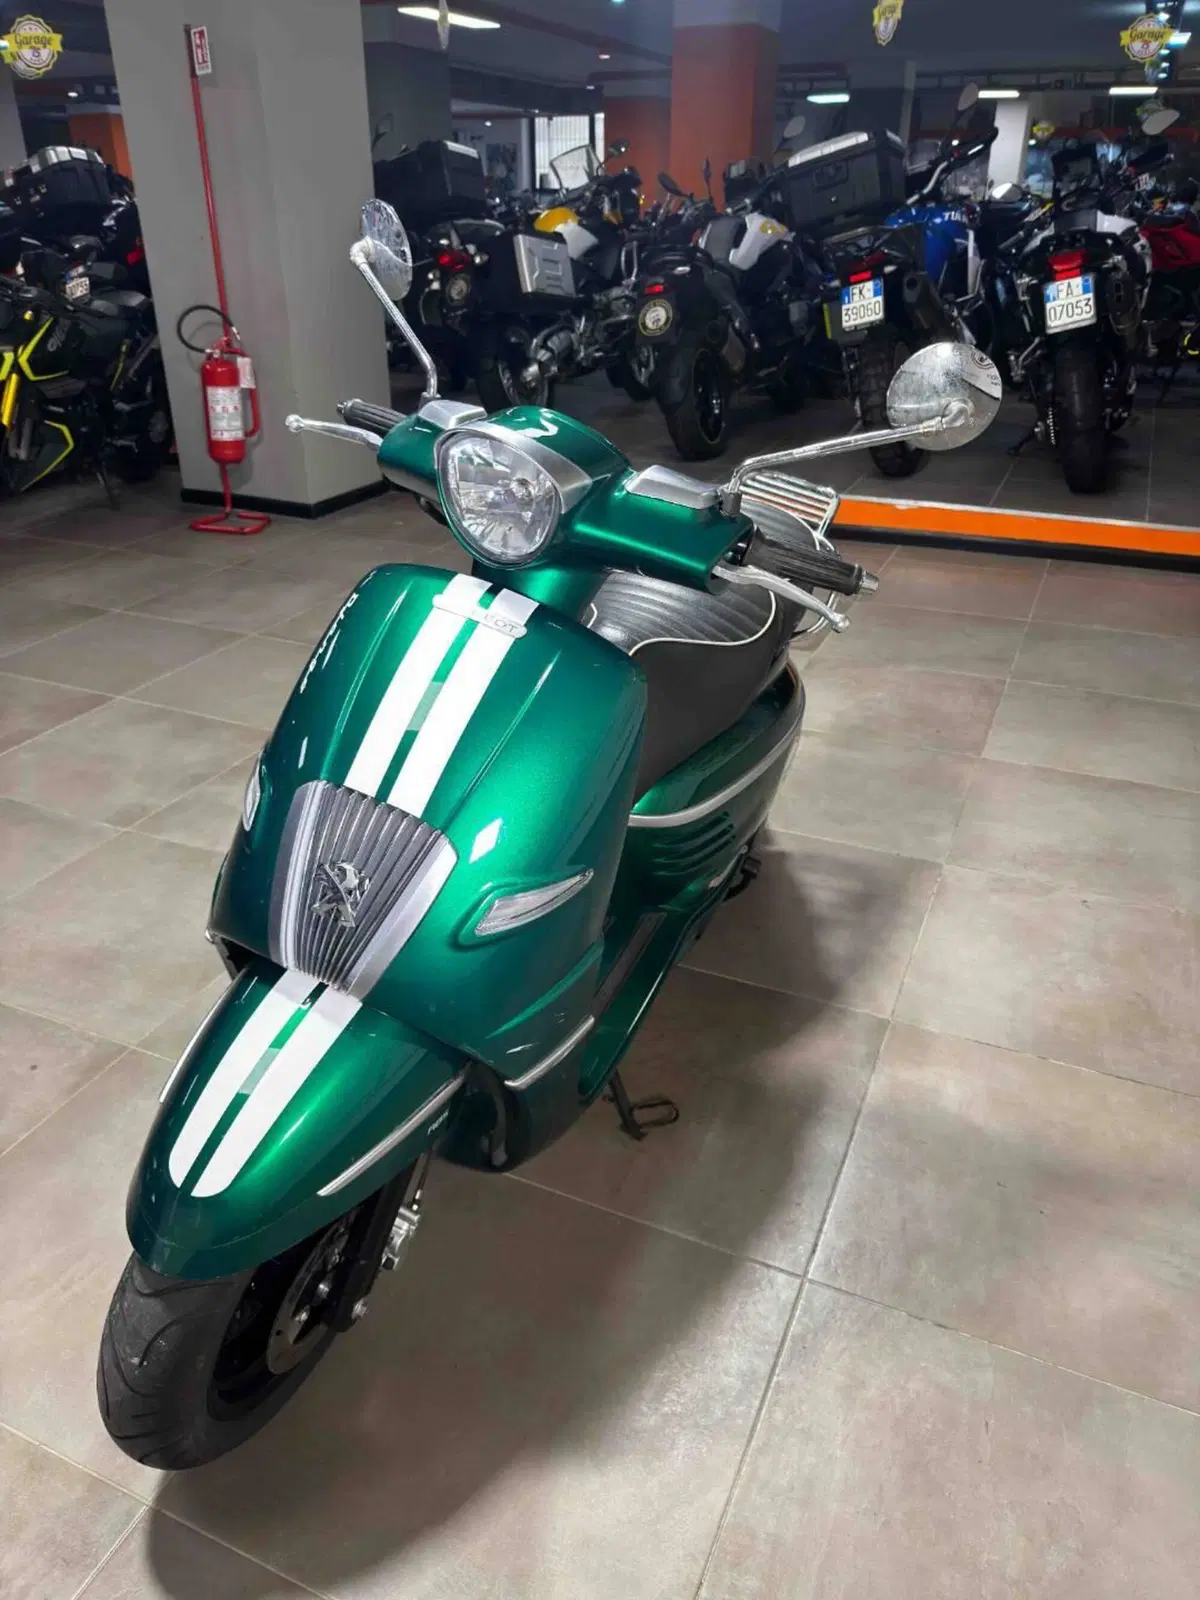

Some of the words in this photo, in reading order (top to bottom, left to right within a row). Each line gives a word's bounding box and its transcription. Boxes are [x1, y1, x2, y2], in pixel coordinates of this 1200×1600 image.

[14, 34, 53, 49] Garage
[851, 284, 866, 301] FK
[1057, 281, 1074, 299] FA
[843, 300, 881, 323] 39060
[1049, 297, 1092, 322] 07053
